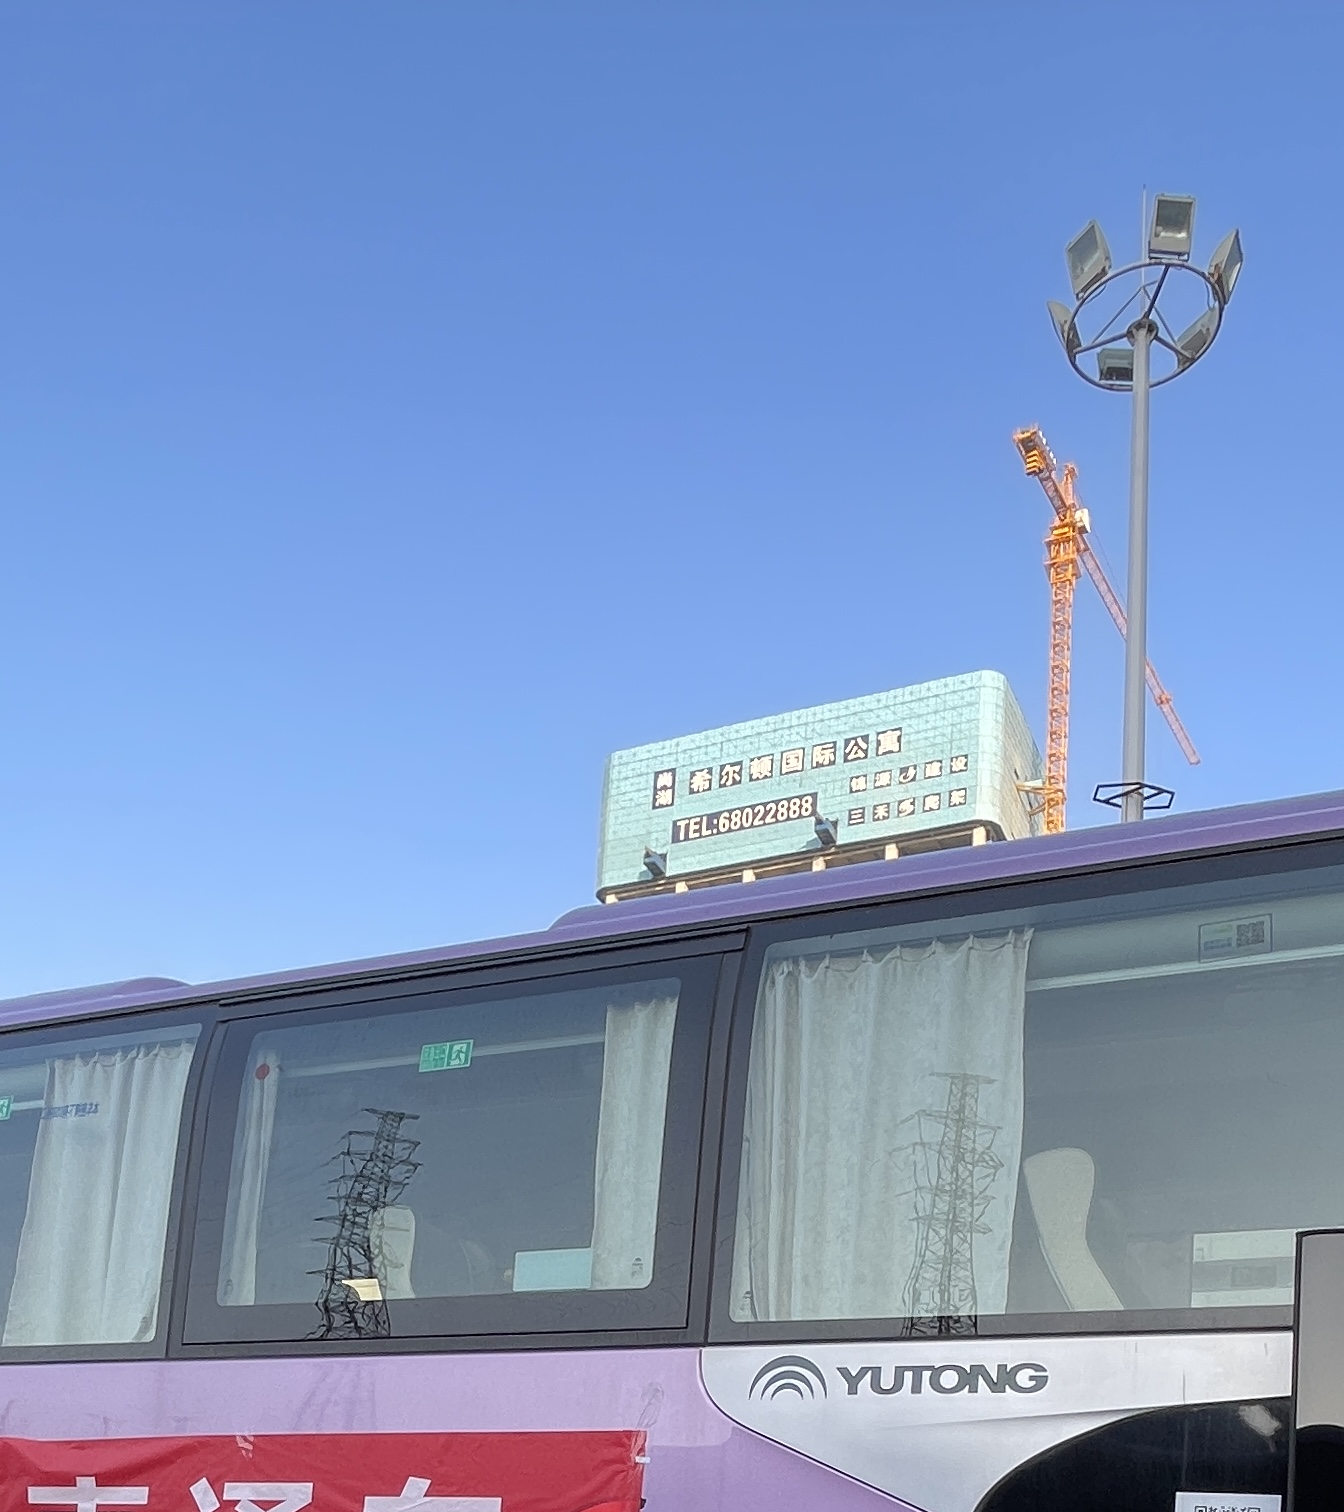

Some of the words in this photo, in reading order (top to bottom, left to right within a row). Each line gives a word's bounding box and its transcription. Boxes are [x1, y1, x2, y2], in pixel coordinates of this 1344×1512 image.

[690, 729, 902, 793] 希尔顿国际公寓
[676, 795, 813, 841] TEL:68022888
[836, 1361, 1049, 1396] YUTONG
